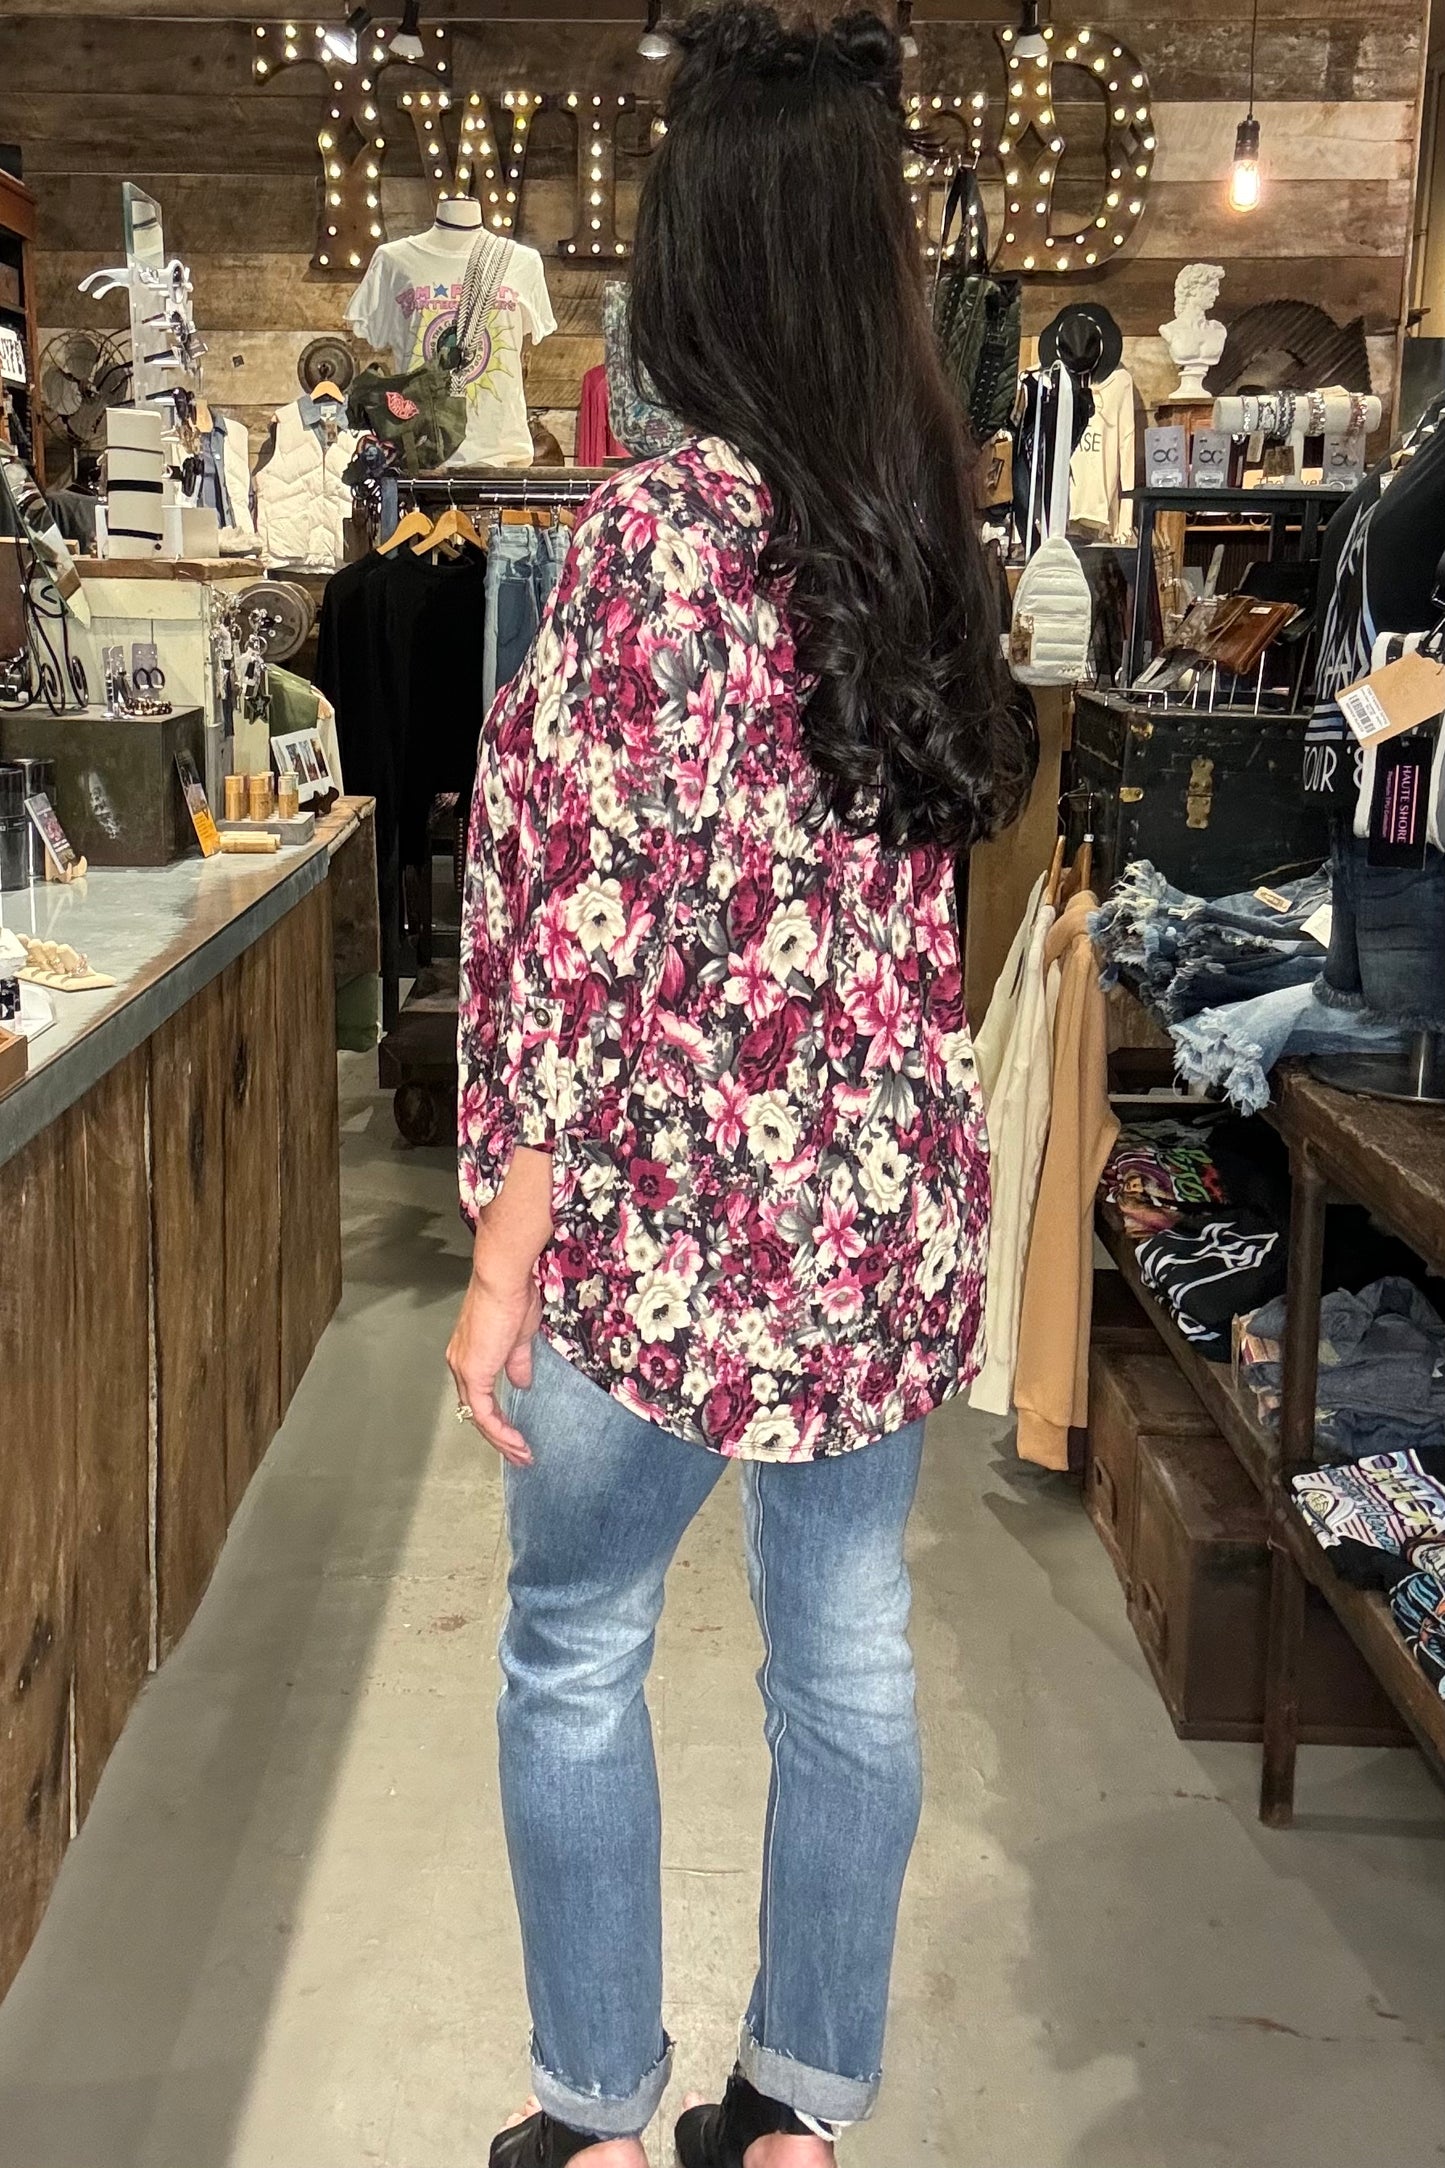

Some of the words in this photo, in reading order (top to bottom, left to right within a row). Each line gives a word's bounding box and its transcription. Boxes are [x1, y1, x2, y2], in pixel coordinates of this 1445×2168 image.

[252, 20, 1156, 276] TWIED
[1400, 765, 1412, 803] HAUTE
[1397, 804, 1409, 843] SHORE
